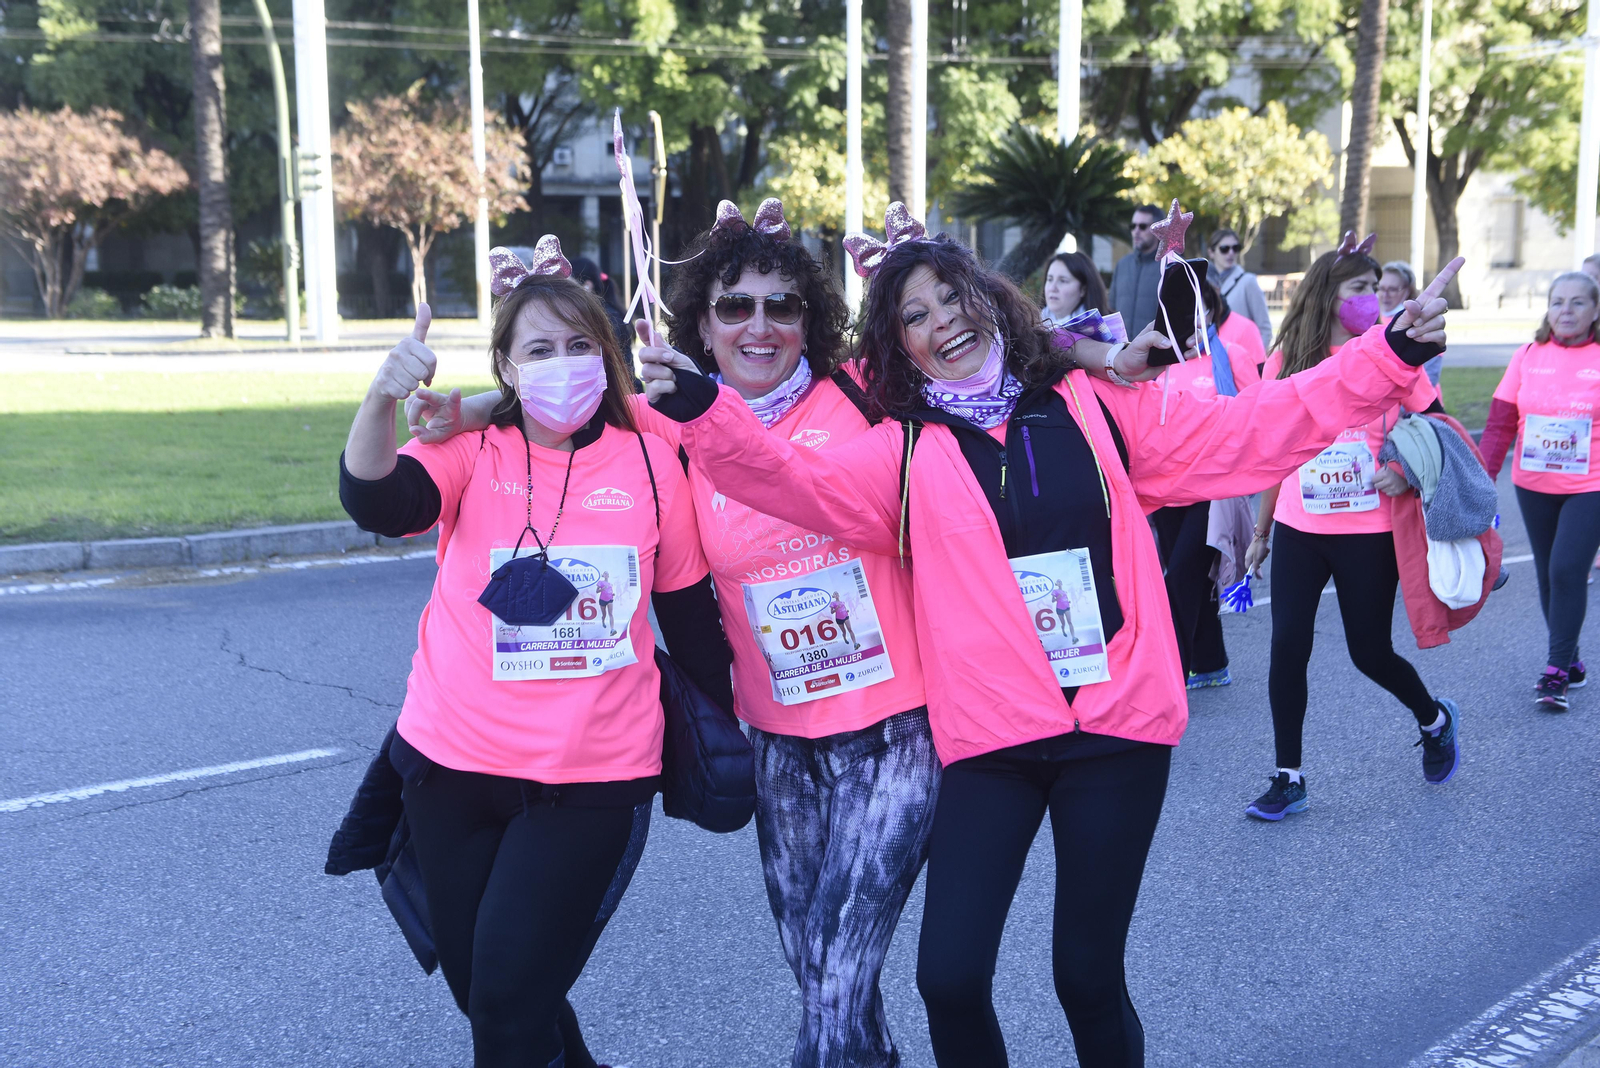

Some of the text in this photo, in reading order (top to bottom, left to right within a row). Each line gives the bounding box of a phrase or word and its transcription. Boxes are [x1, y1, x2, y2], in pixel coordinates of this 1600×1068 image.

[1570, 401, 1593, 411] POR
[1542, 439, 1570, 451] 016
[1320, 471, 1354, 485] 016
[586, 497, 630, 507] ASTURIANA
[745, 547, 850, 581] NOSOTRAS
[773, 596, 827, 616] ASTURIANA
[551, 627, 582, 639] 1681
[780, 619, 838, 651] 016
[520, 639, 616, 651] CARRERA DE LA MUJER
[799, 648, 829, 663] 1380
[1050, 647, 1080, 660] MUJER
[500, 659, 544, 672] OYSHO
[775, 652, 863, 680] CARRERA DE LA MUJER
[857, 665, 883, 678] ZURICH
[1073, 665, 1100, 675] ZURICH
